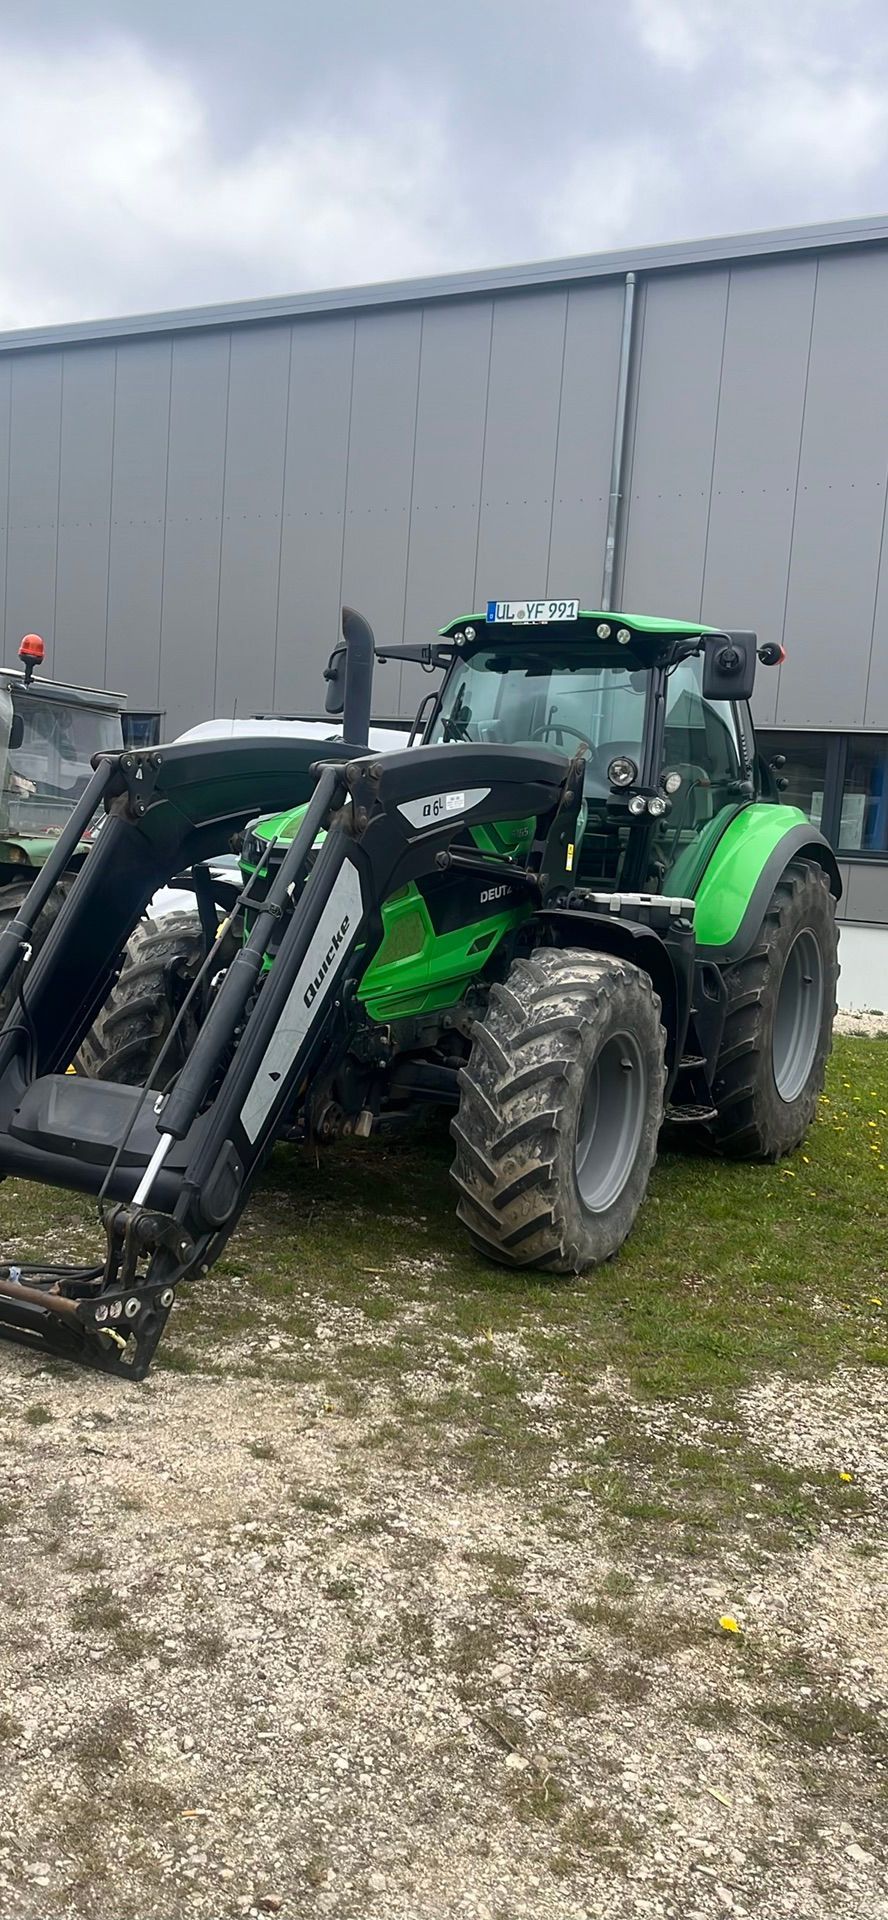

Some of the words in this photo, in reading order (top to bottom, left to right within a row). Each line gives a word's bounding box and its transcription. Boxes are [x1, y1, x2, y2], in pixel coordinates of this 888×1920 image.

[496, 604, 515, 620] UL
[526, 603, 545, 619] YF
[549, 602, 575, 618] 991
[303, 914, 350, 1009] Quicke
